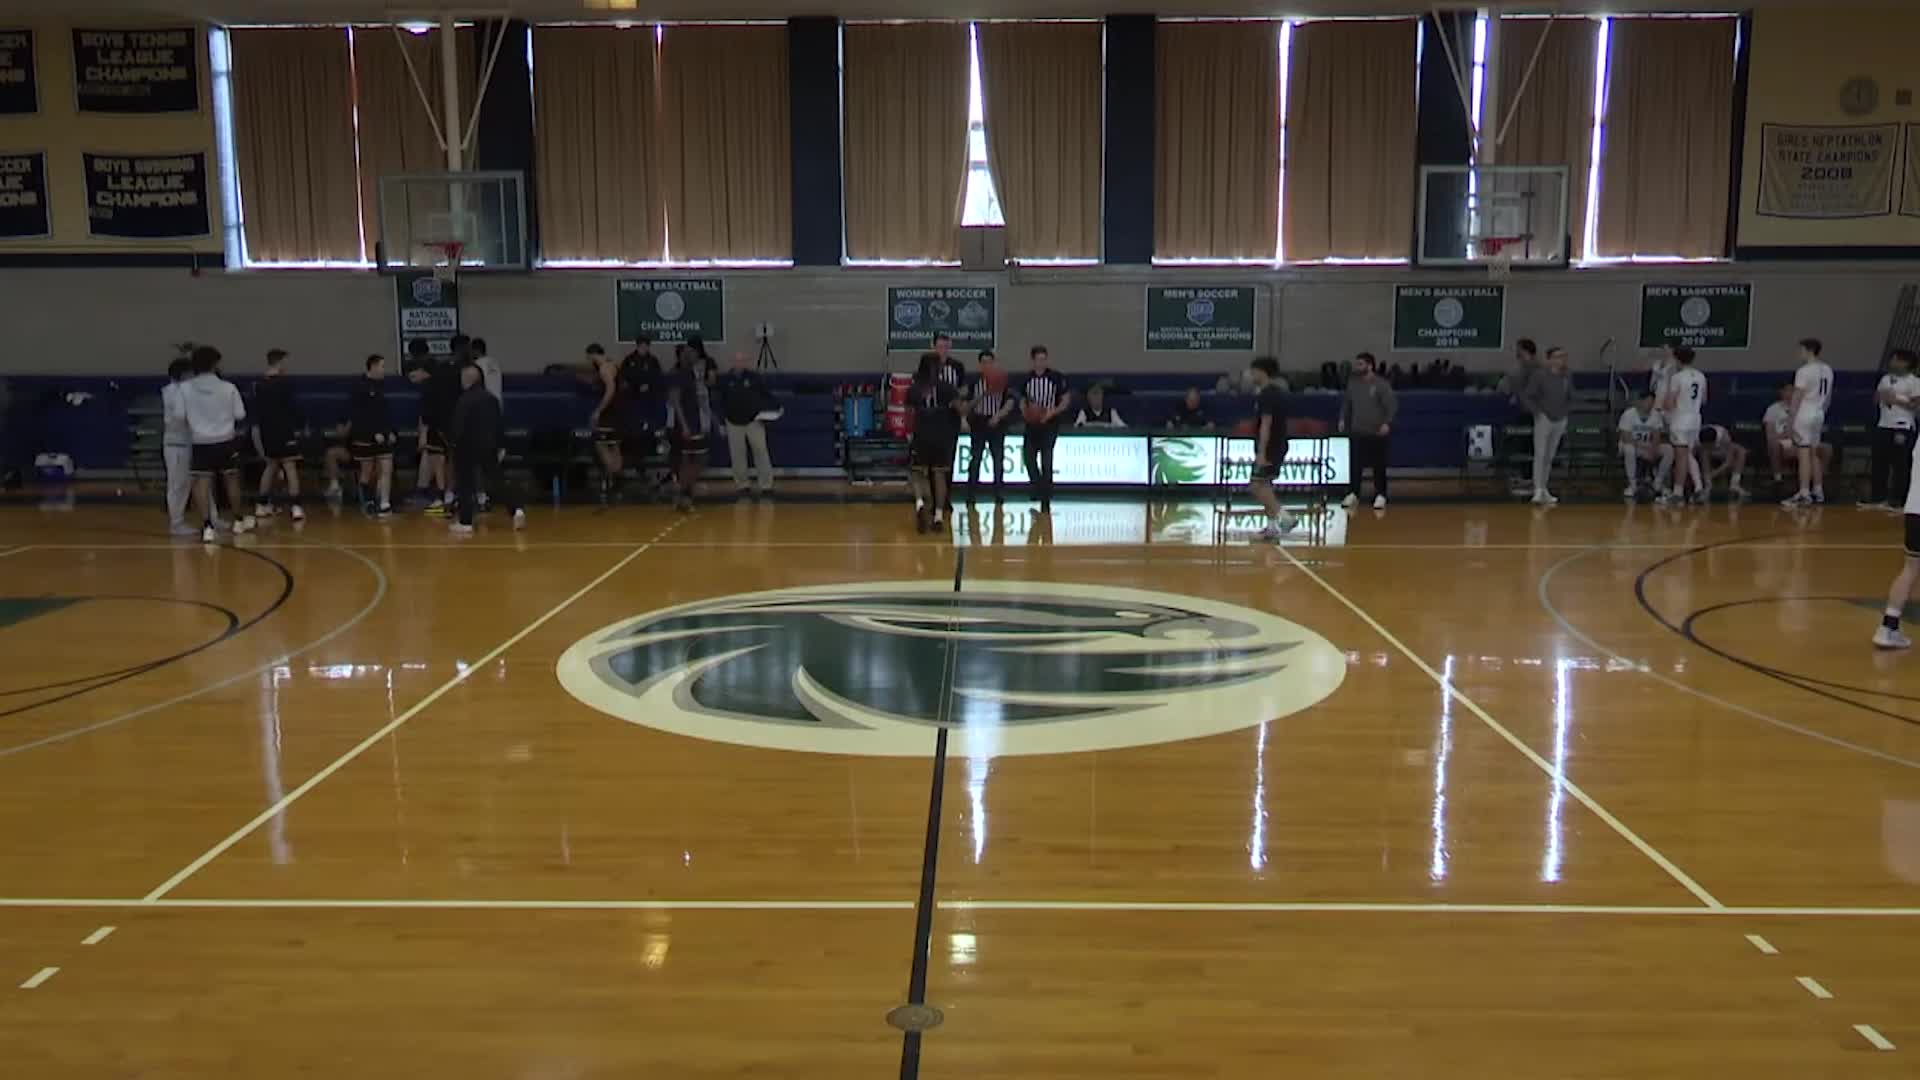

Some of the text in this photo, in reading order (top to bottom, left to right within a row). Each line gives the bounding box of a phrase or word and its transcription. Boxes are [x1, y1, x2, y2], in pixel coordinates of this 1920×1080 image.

[97, 49, 175, 64] LEAGUE
[85, 65, 187, 80] CHAMPIONS
[1777, 133, 1808, 146] GIRLS
[1778, 150, 1880, 162] STATE CHAMPIONS
[107, 174, 184, 190] LEAGUE
[96, 190, 198, 206] CHAMPIONS
[653, 281, 718, 291] BASKETBALL
[1680, 286, 1745, 296] BASKETBALL
[896, 288, 987, 299] WOMEN'S SOCCER
[1162, 288, 1239, 299] MEN'S SOCCER
[1433, 287, 1498, 297] BASKETBALL
[409, 311, 449, 319] NATIONAL
[406, 319, 453, 327] QUALIFIERS
[640, 321, 701, 330] CHAMPIONS
[1148, 331, 1252, 340] REGIONAL CHAMPIONS
[1416, 328, 1479, 337] CHAMPIONS
[1662, 327, 1725, 337] CHAMPIONS
[1690, 383, 1699, 400] 3
